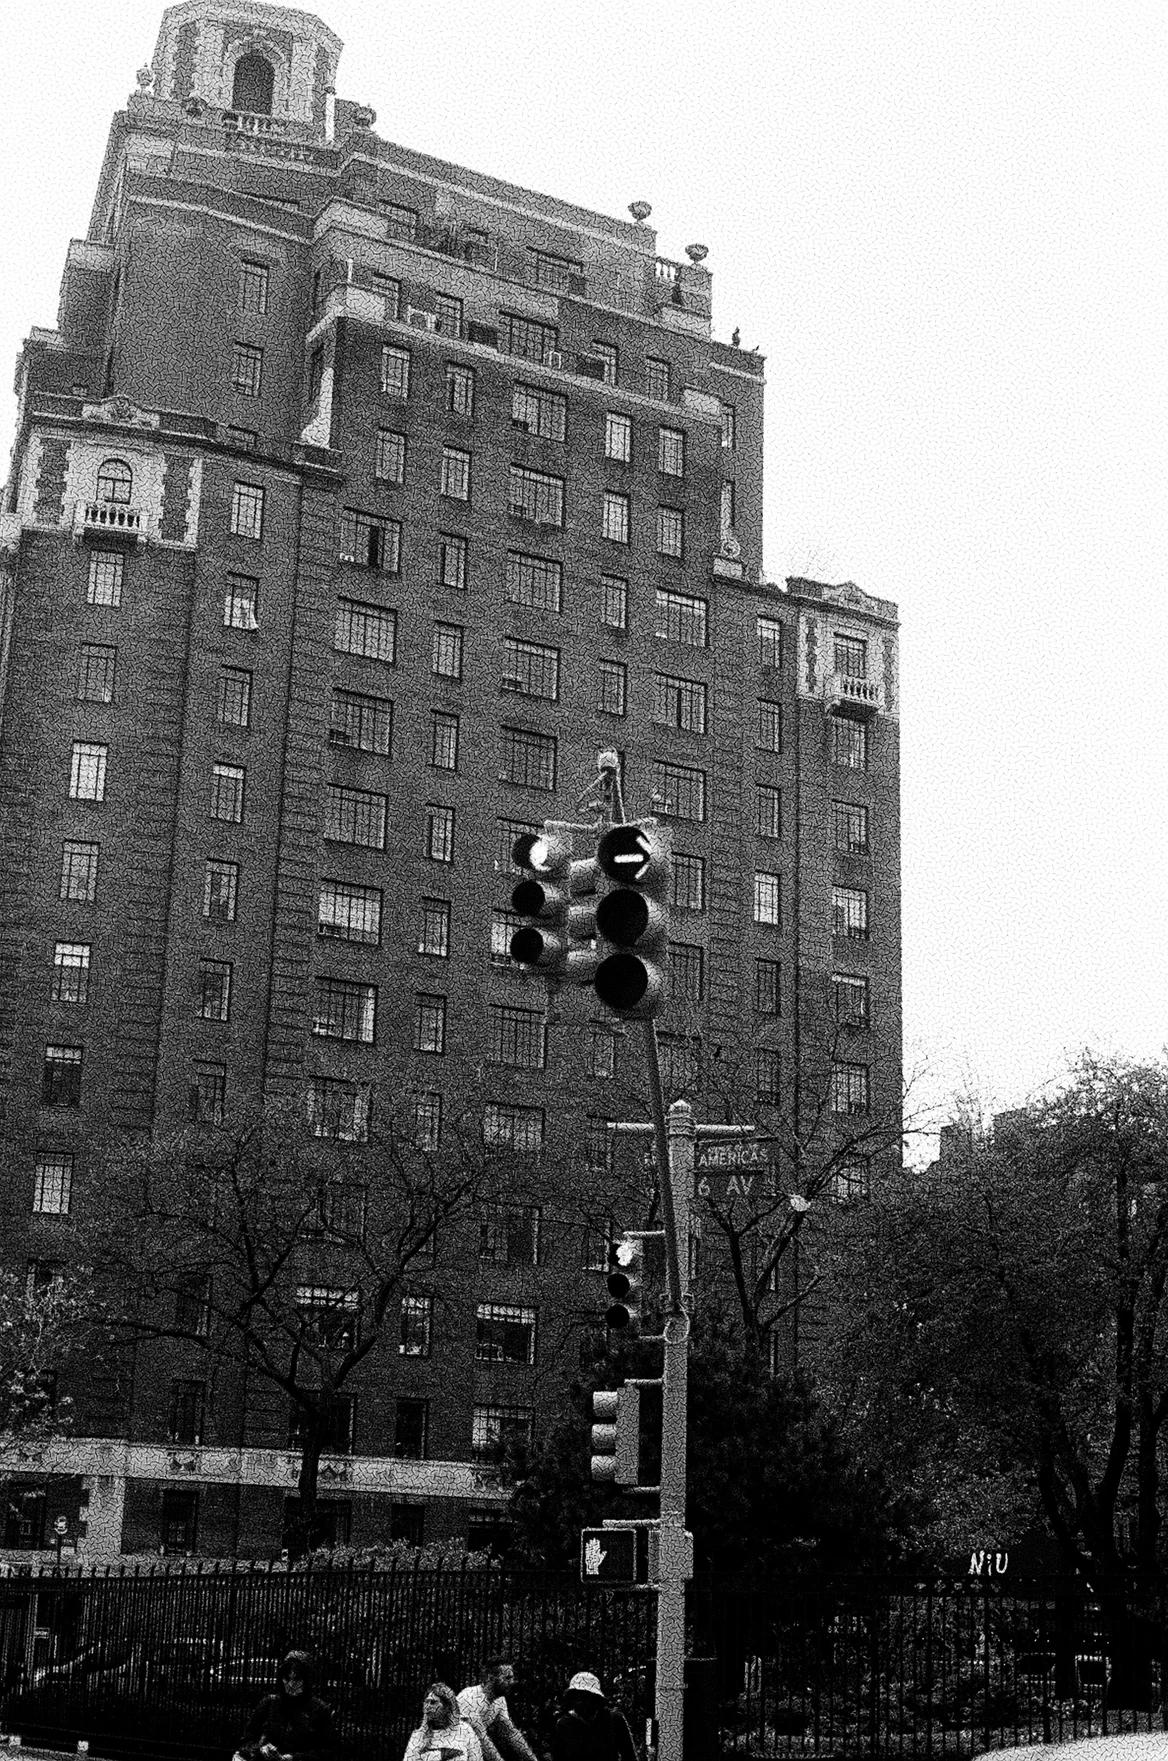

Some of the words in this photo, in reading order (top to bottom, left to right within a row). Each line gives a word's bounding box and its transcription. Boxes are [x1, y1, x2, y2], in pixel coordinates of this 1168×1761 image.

[698, 1149, 769, 1166] AMERICAS
[698, 1176, 711, 1196] 6
[726, 1175, 754, 1196] AV
